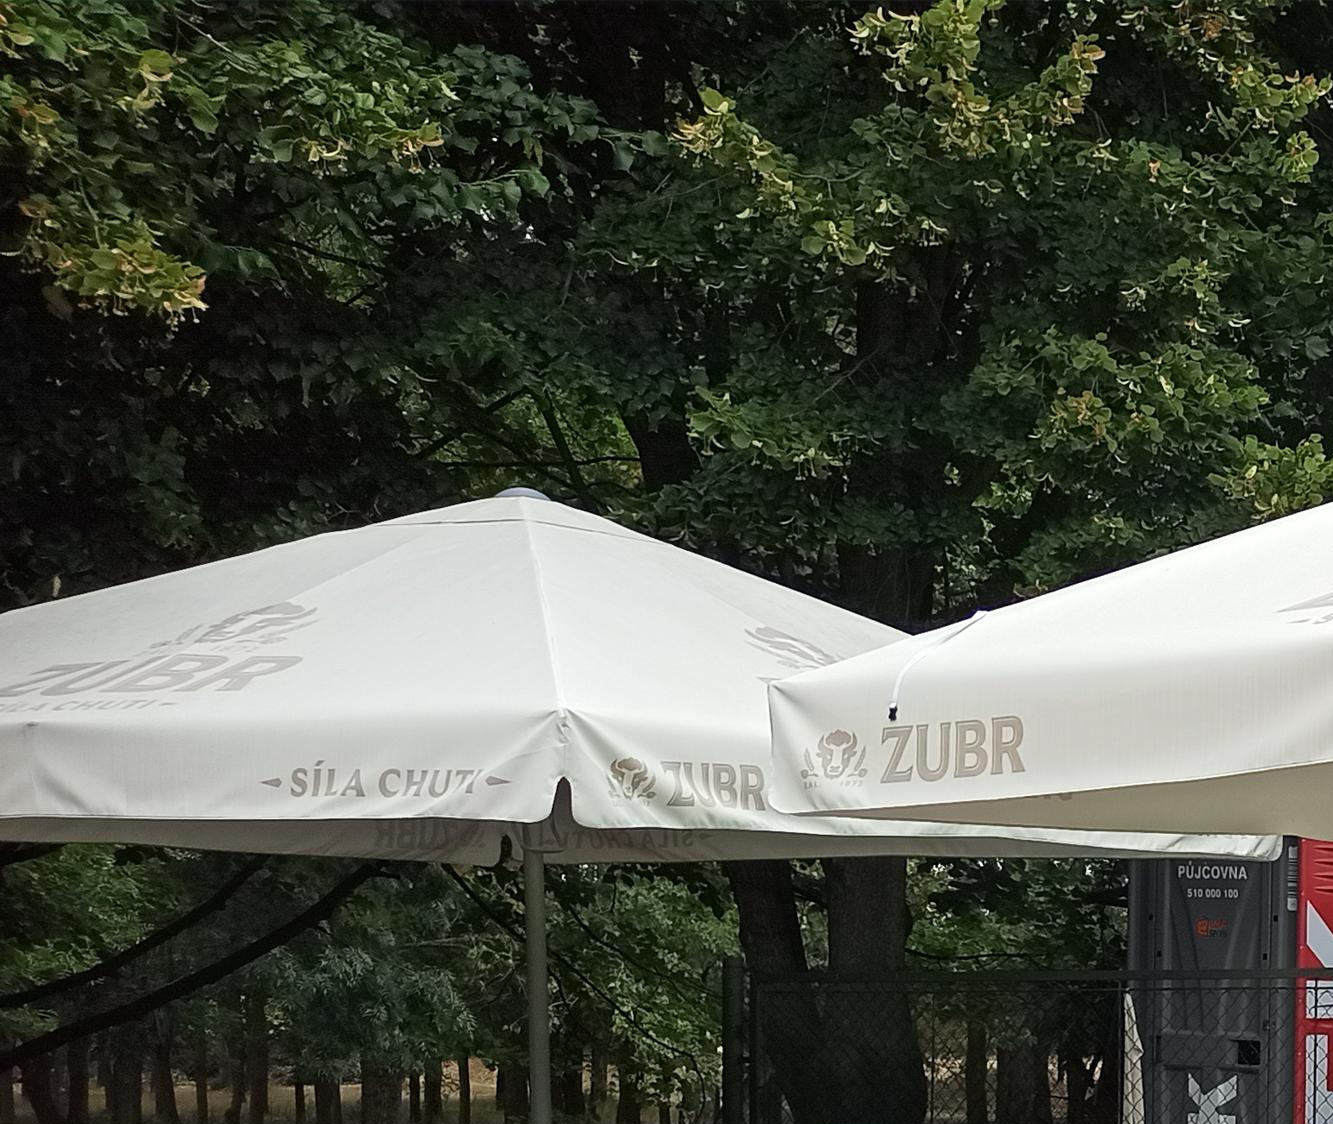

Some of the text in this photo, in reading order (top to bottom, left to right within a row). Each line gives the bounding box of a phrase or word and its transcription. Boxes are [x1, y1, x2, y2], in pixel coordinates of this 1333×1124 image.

[0, 653, 303, 697] ZUBR
[880, 715, 1025, 783] ZUBR
[290, 760, 483, 798] SÍLA CHUTI
[661, 761, 766, 811] ZUBR
[1187, 888, 1239, 899] 510 000 100
